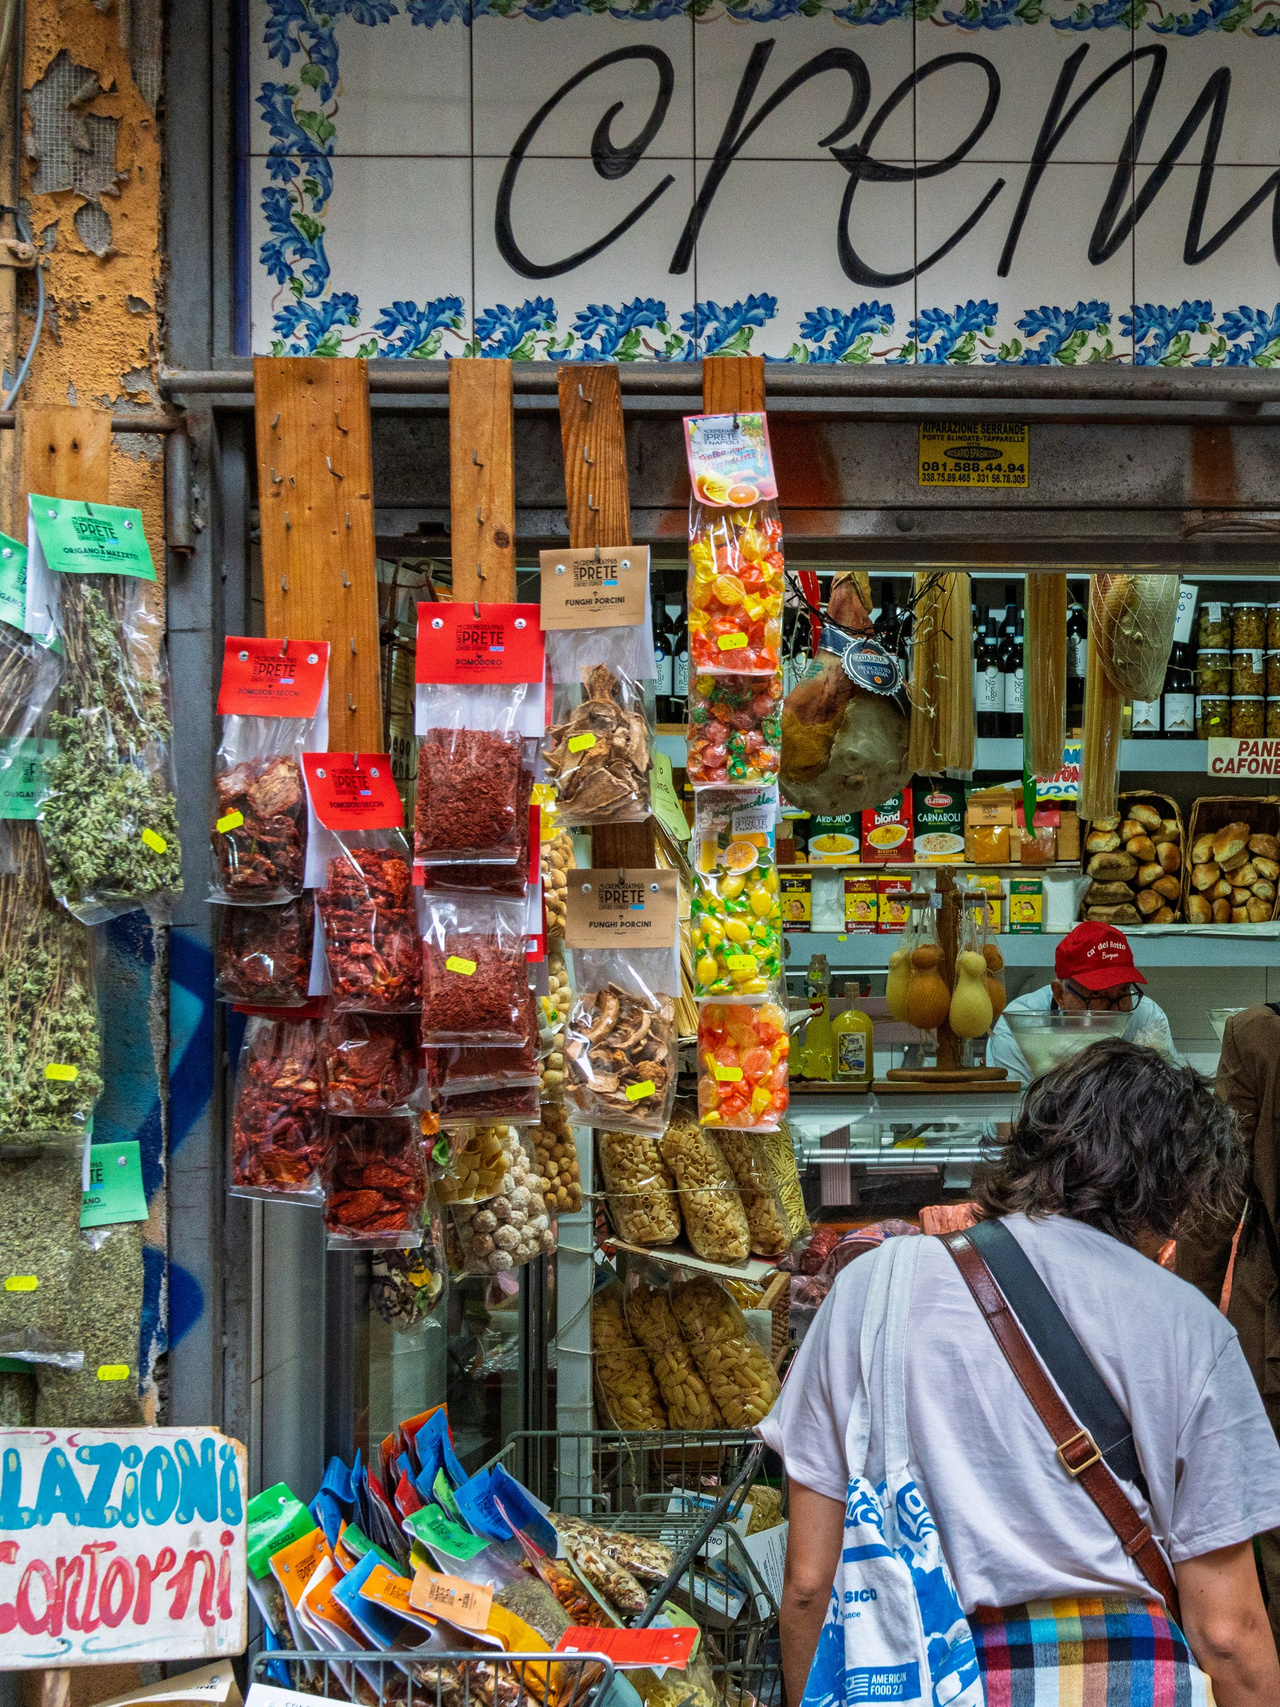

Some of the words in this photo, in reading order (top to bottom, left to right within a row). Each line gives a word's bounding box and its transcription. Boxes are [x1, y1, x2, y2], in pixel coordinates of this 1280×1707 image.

[922, 422, 979, 434] RIPARAZIONE
[981, 423, 1025, 435] SERRANDE
[922, 461, 1025, 473] 081.588.44.94
[79, 522, 119, 540] PRETE
[64, 547, 101, 555] ORIGANO
[106, 549, 139, 560] MAZZETTI
[579, 566, 618, 580] PRETE
[565, 597, 593, 606] FUNGHI
[594, 596, 625, 605] PORCINI
[462, 631, 504, 645] PRETE
[258, 663, 296, 677] PRETE
[857, 665, 891, 674] PROSCIUTTO
[338, 775, 370, 789] PRETE
[329, 800, 362, 808] POMODORI
[739, 819, 767, 827] PRETE
[875, 812, 900, 825] blond
[917, 813, 961, 823] CARNAROLI
[604, 890, 645, 904] PRETE
[589, 921, 619, 929] FUNGHI
[620, 920, 652, 928] PORCINI
[1098, 941, 1109, 950] del
[1110, 941, 1126, 951] Botto
[843, 1587, 878, 1605] SICO
[871, 1673, 908, 1686] AMERICAN
[871, 1686, 892, 1697] FOOD
